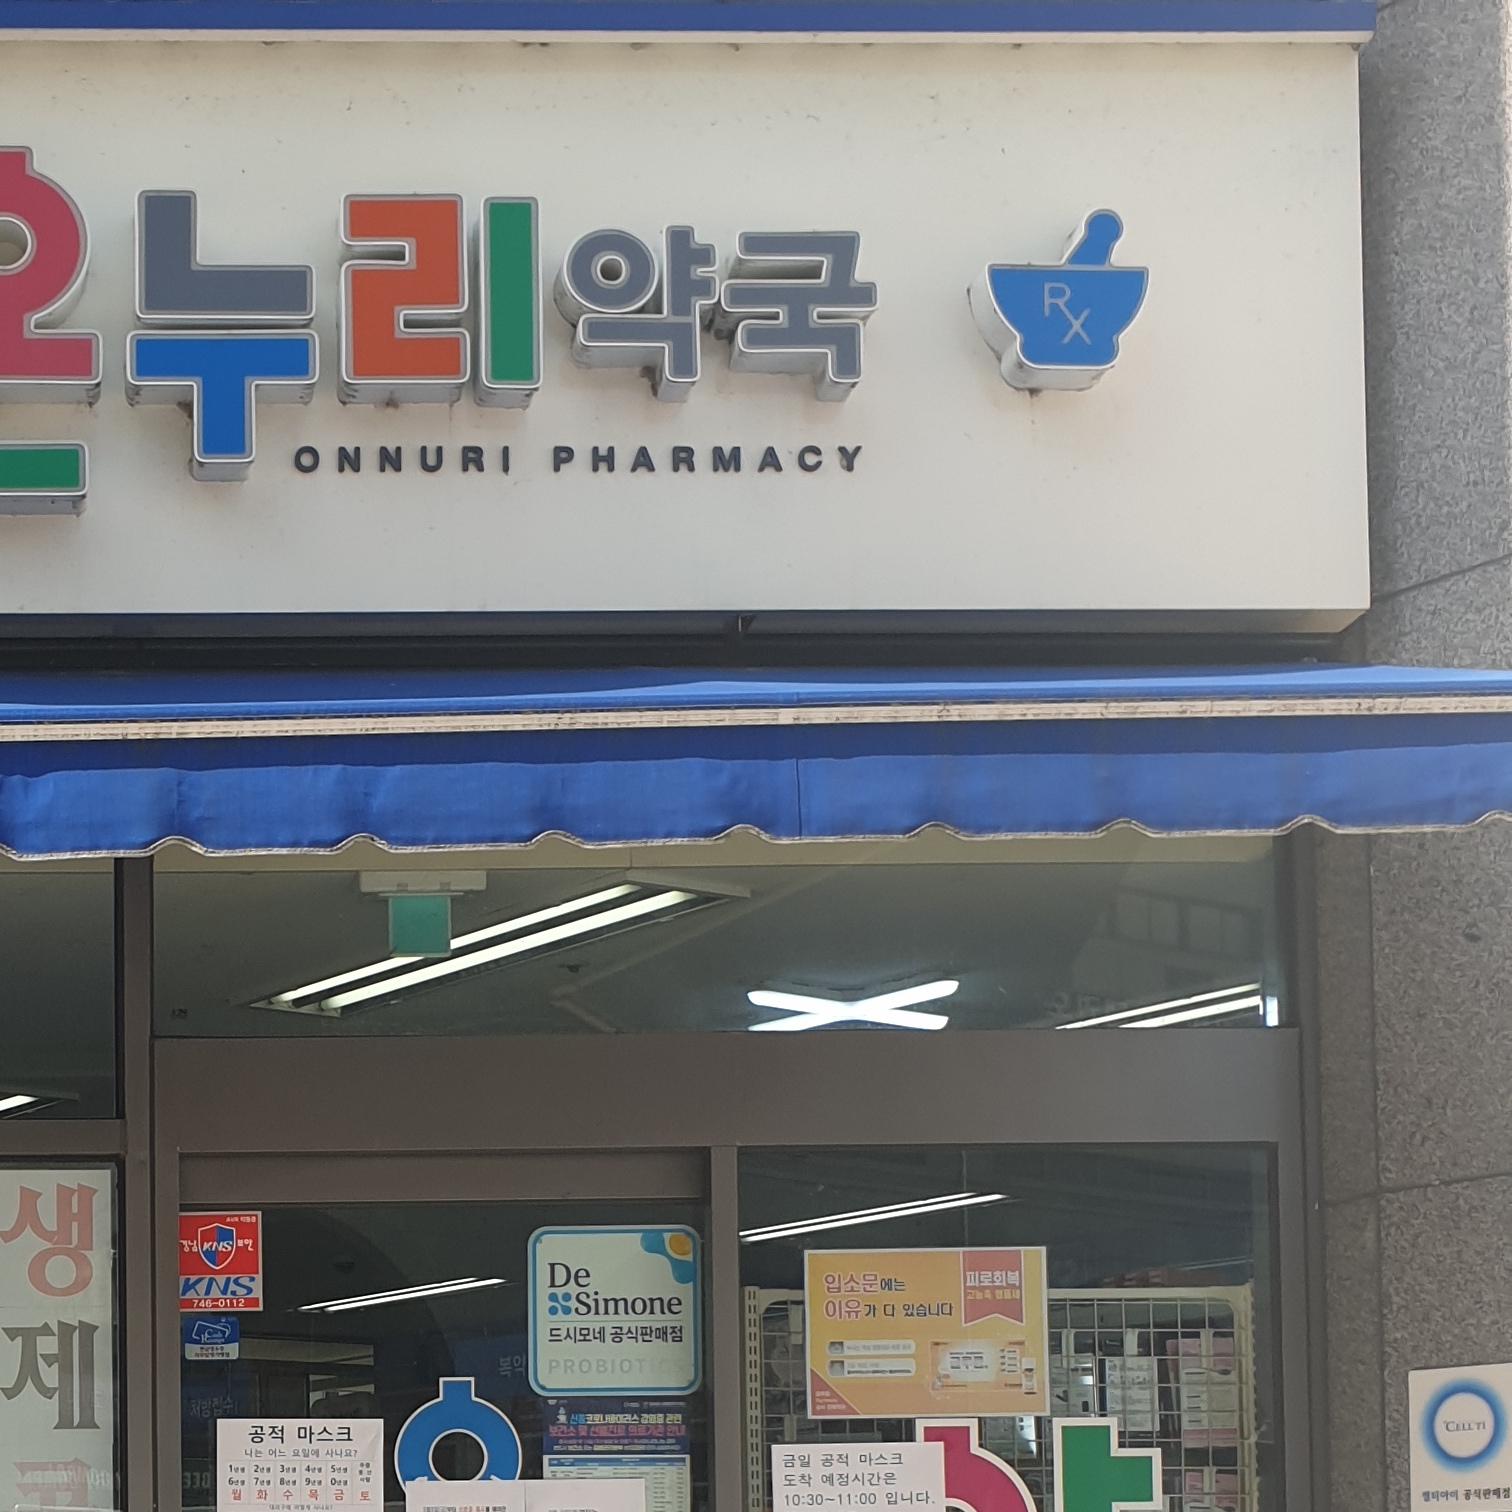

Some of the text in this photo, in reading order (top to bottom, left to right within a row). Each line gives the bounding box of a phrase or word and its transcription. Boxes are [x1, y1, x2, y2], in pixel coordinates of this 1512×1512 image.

[294, 445, 865, 473] ONNURI PHARMACY
[202, 1241, 233, 1251] KNS
[548, 1262, 591, 1288] De
[824, 1271, 906, 1294] 입소문에는
[966, 1270, 1020, 1287] 피로회복
[181, 1276, 255, 1297] KNS
[193, 1299, 245, 1308] 746-0112
[574, 1291, 682, 1316] Simone
[825, 1299, 954, 1320] 이유가 다 있습니다
[548, 1325, 683, 1344] 드시모네 공식판매점
[248, 1425, 353, 1444] 공적 마스크
[244, 1448, 357, 1458] 나는 어느 요일에 사나요?
[782, 1452, 904, 1467] 금일 공적 마스크
[783, 1472, 897, 1487] 도착 예정시간은
[231, 1489, 371, 1501] 월 화 수 목 금 토
[784, 1490, 936, 1506] 10:30~11:00 입니다.
[1463, 1487, 1511, 1501] 공식판매점
